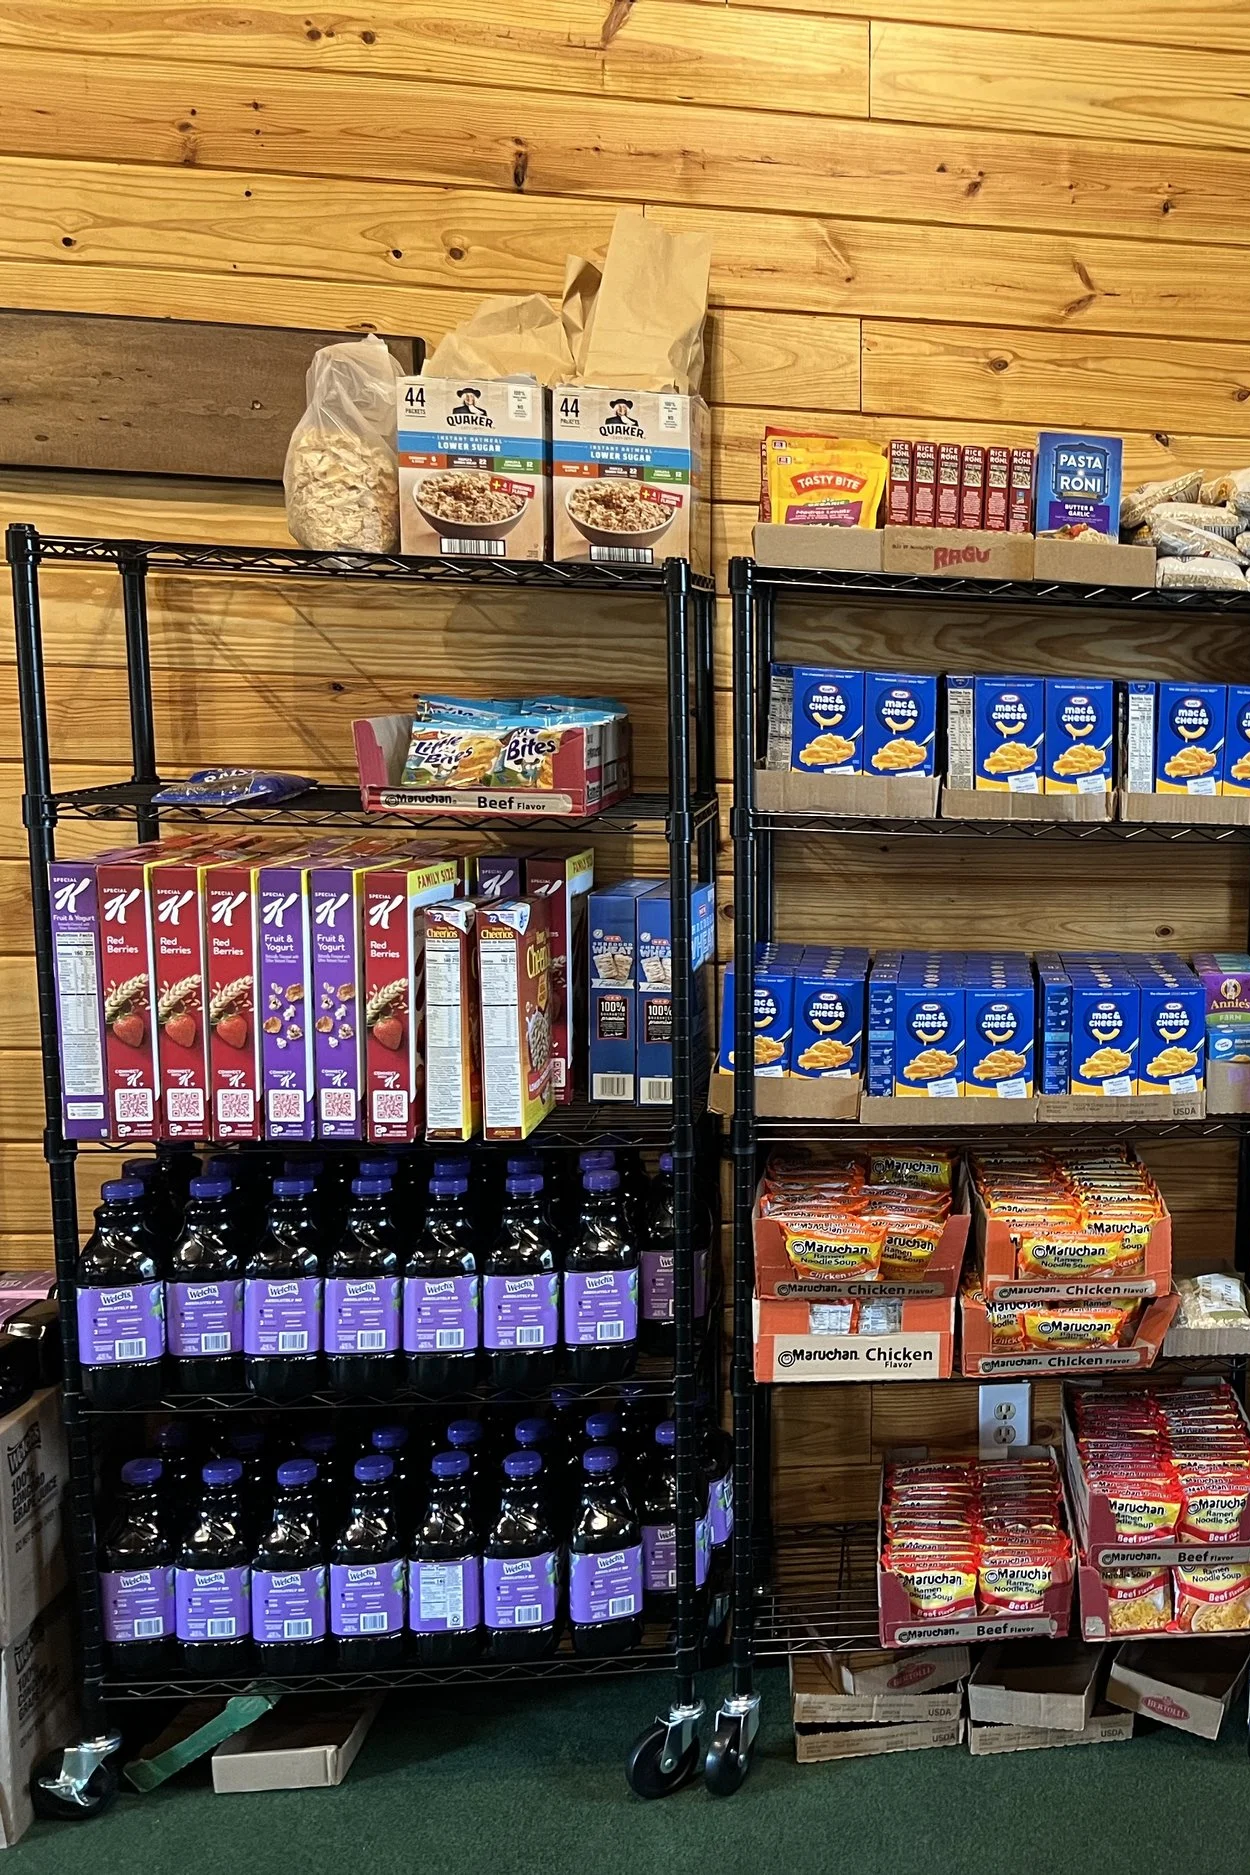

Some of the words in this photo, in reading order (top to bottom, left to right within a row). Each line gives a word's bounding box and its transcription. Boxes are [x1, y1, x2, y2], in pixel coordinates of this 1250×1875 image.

[405, 387, 426, 407] 44
[560, 398, 579, 417] 44
[446, 414, 493, 429] QUAKER
[599, 425, 644, 439] QUAKER
[468, 436, 502, 444] OATMEAL
[438, 441, 469, 450] LOWER
[472, 443, 501, 452] SUGAR
[591, 451, 621, 460] LOWER
[624, 453, 651, 462] SUGAR
[965, 449, 982, 457] RICE
[1013, 450, 1031, 458] RICE
[1060, 454, 1102, 469] PASTA
[798, 475, 834, 489] TASTY
[836, 476, 861, 490] BITE
[1060, 477, 1101, 492] RONI
[415, 736, 463, 755] Little
[507, 740, 556, 760] Bites
[424, 748, 473, 764] Bites
[398, 793, 452, 806] Maruchan
[477, 797, 515, 809] Beef
[417, 871, 439, 889] FAMILY
[441, 868, 455, 883] SIZE
[53, 877, 91, 913] K
[104, 888, 141, 925] K
[263, 893, 299, 928] K
[369, 894, 405, 929] K
[75, 915, 95, 923] Yogurt
[265, 934, 284, 943] Fruit
[286, 934, 293, 942] &
[427, 929, 457, 938] Cheerios
[481, 929, 513, 939] Cheerios
[107, 936, 124, 944] Red
[370, 941, 386, 949] Red
[107, 945, 138, 954] Berries
[265, 943, 293, 952] Yogurt
[371, 950, 400, 958] Berries
[601, 1002, 625, 1012] 100%
[1211, 999, 1250, 1010] Annie's
[1173, 1107, 1196, 1116] USDA
[885, 1158, 940, 1173] Maruchan
[804, 1241, 868, 1255] Maruchan
[1046, 1245, 1105, 1257] Maruchan
[809, 1271, 846, 1279] Chicken
[788, 1284, 838, 1293] Maruchan
[848, 1285, 906, 1295] Chicken
[1008, 1286, 1056, 1295] Maruchan
[1066, 1285, 1121, 1295] Chicken
[1123, 1286, 1148, 1294] Flavor
[793, 1349, 859, 1361] Maruchan
[866, 1348, 933, 1361] Chicken
[991, 1358, 1038, 1367] Maruchan
[1048, 1357, 1103, 1366] Chicken
[1117, 1535, 1137, 1543] Beef
[1112, 1552, 1157, 1562] Maruchan
[1178, 1552, 1209, 1563] Beef
[904, 1574, 962, 1586] Maruchan
[1192, 1574, 1220, 1582] Noodle
[1222, 1572, 1241, 1580] Soup
[1209, 1593, 1228, 1601] Beef
[1009, 1602, 1028, 1610] Beef
[908, 1628, 955, 1638] Maruchan
[977, 1624, 1008, 1636] Beef
[928, 1708, 952, 1717] USDA
[1146, 1700, 1187, 1718] BERTOLLI
[1101, 1728, 1124, 1738] USDA
